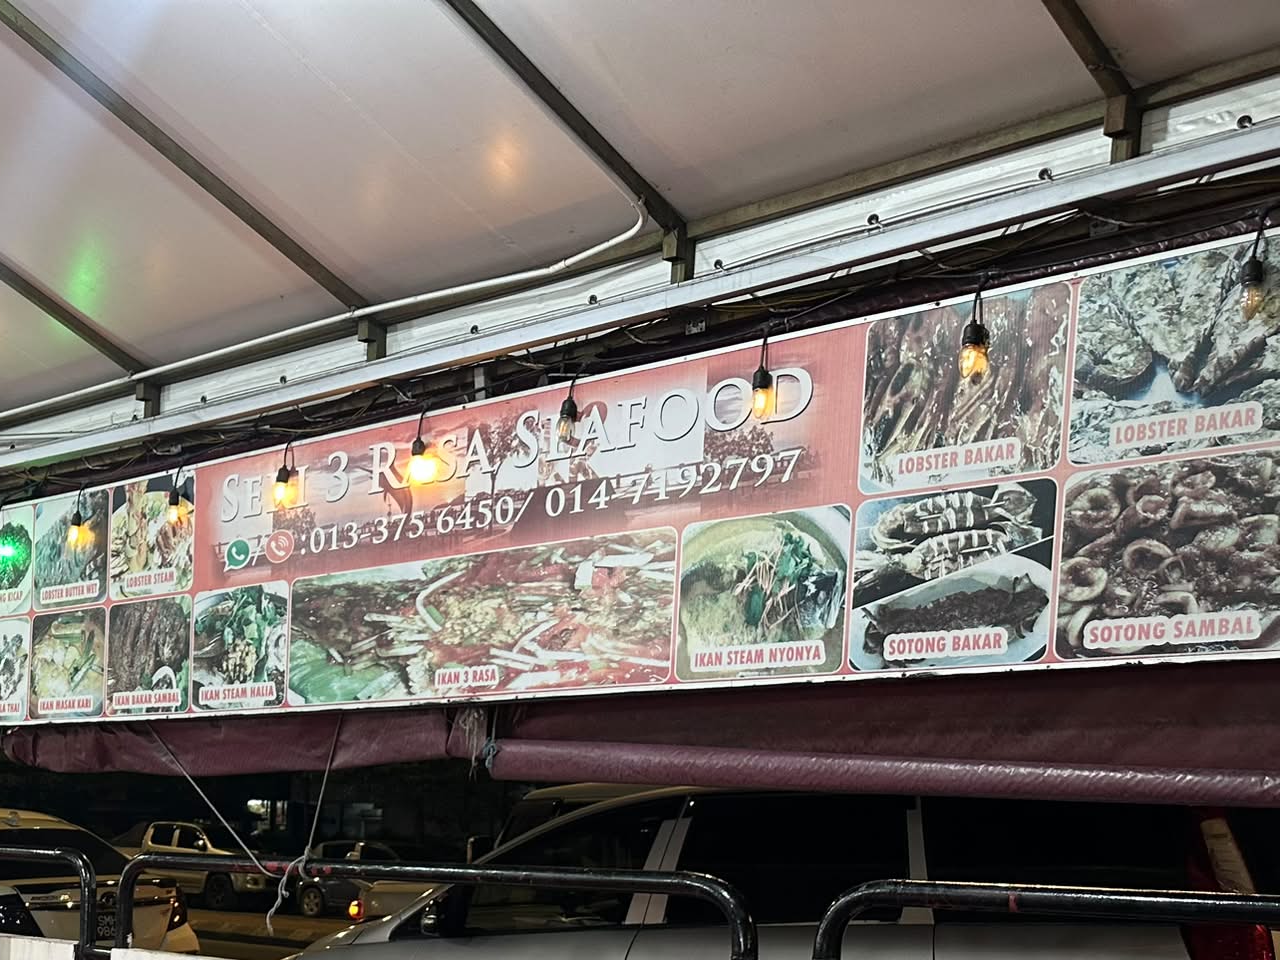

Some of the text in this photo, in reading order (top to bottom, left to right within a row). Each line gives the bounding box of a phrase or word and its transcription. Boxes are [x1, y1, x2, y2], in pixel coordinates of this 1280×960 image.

[1116, 407, 1257, 445] LOBSTER BAKAR
[898, 442, 1016, 475] LOBSTER BAKAR
[220, 464, 310, 523] SEI
[325, 450, 351, 503] 3
[368, 428, 497, 496] RSA
[544, 448, 804, 518] 014-7192797
[127, 570, 175, 588] LOBSTER STEAM
[1089, 615, 1254, 644] SOTONG SAMBAL
[888, 632, 1003, 656] SOTONG BAKAR
[694, 645, 822, 668] IKAN STEAM NYONYA
[437, 668, 496, 686] IKAN 3 RASA
[39, 700, 54, 711] IKAN
[55, 699, 76, 710] MASAK
[114, 692, 180, 706] IKAN BAKAR SAMBAL
[201, 685, 274, 702] IKAN STEAM HALIA
